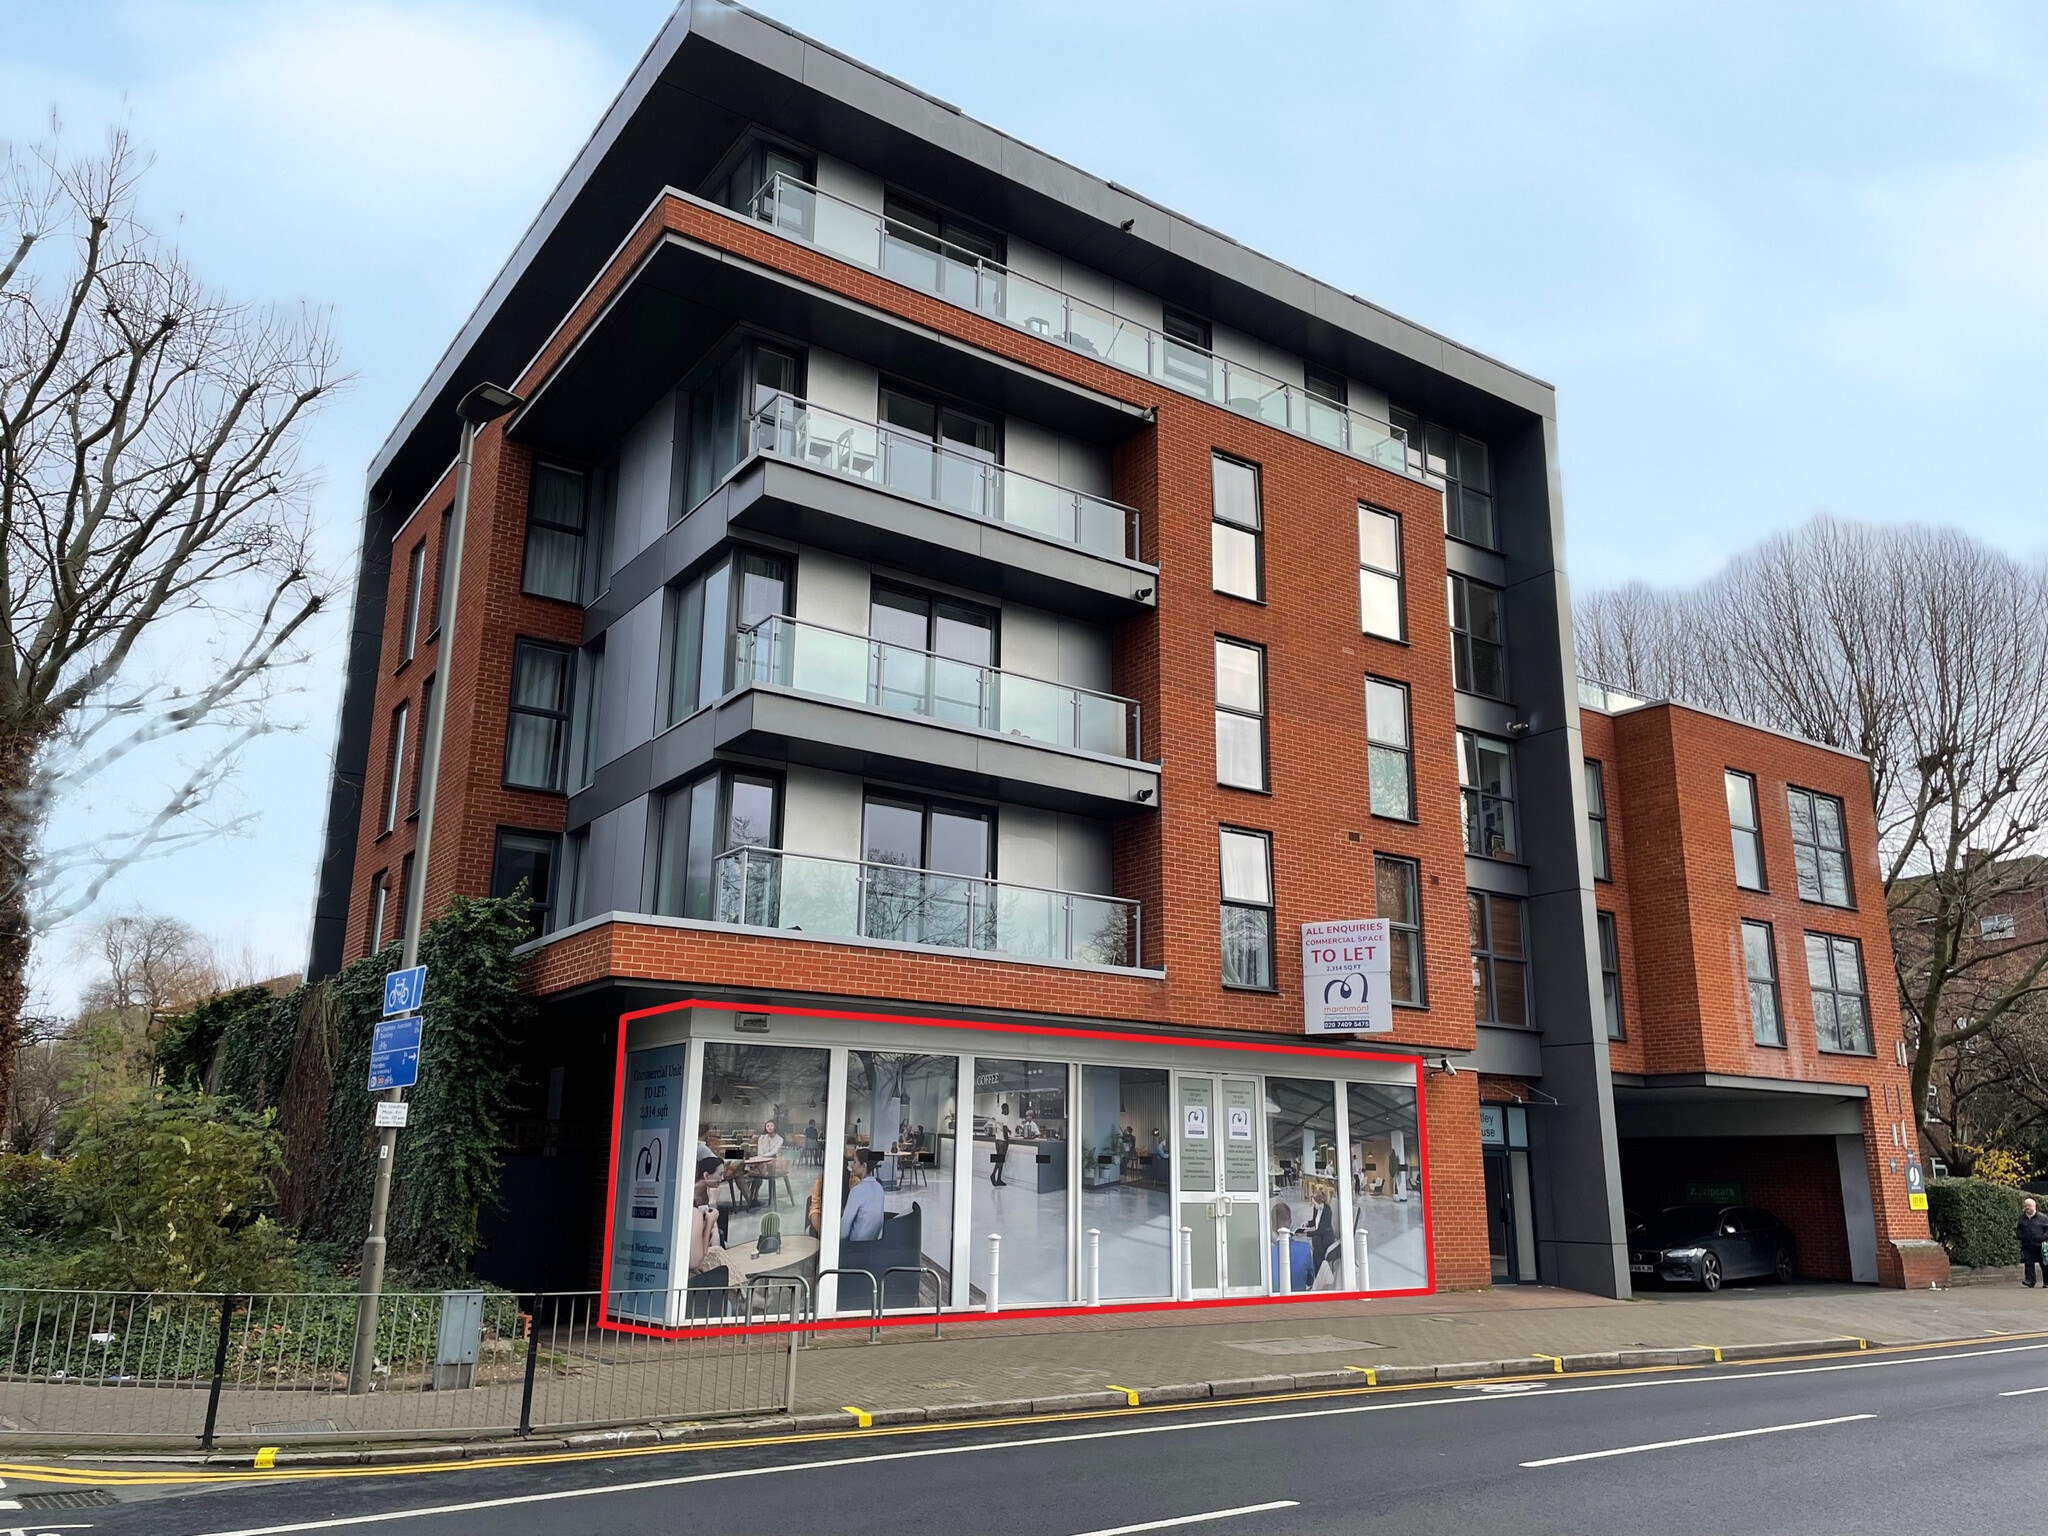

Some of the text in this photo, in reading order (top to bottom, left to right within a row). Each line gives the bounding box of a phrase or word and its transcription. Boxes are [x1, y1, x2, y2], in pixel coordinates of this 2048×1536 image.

[1306, 923, 1383, 936] ALL ENQUIRIES
[1306, 936, 1355, 946] COMMERCIAL
[1311, 946, 1376, 964] TO LET
[634, 1064, 682, 1081] Commercial Unit
[976, 1072, 1000, 1086] COFFEE
[644, 1086, 652, 1099] TO
[640, 1104, 668, 1120] 2,314 sqft
